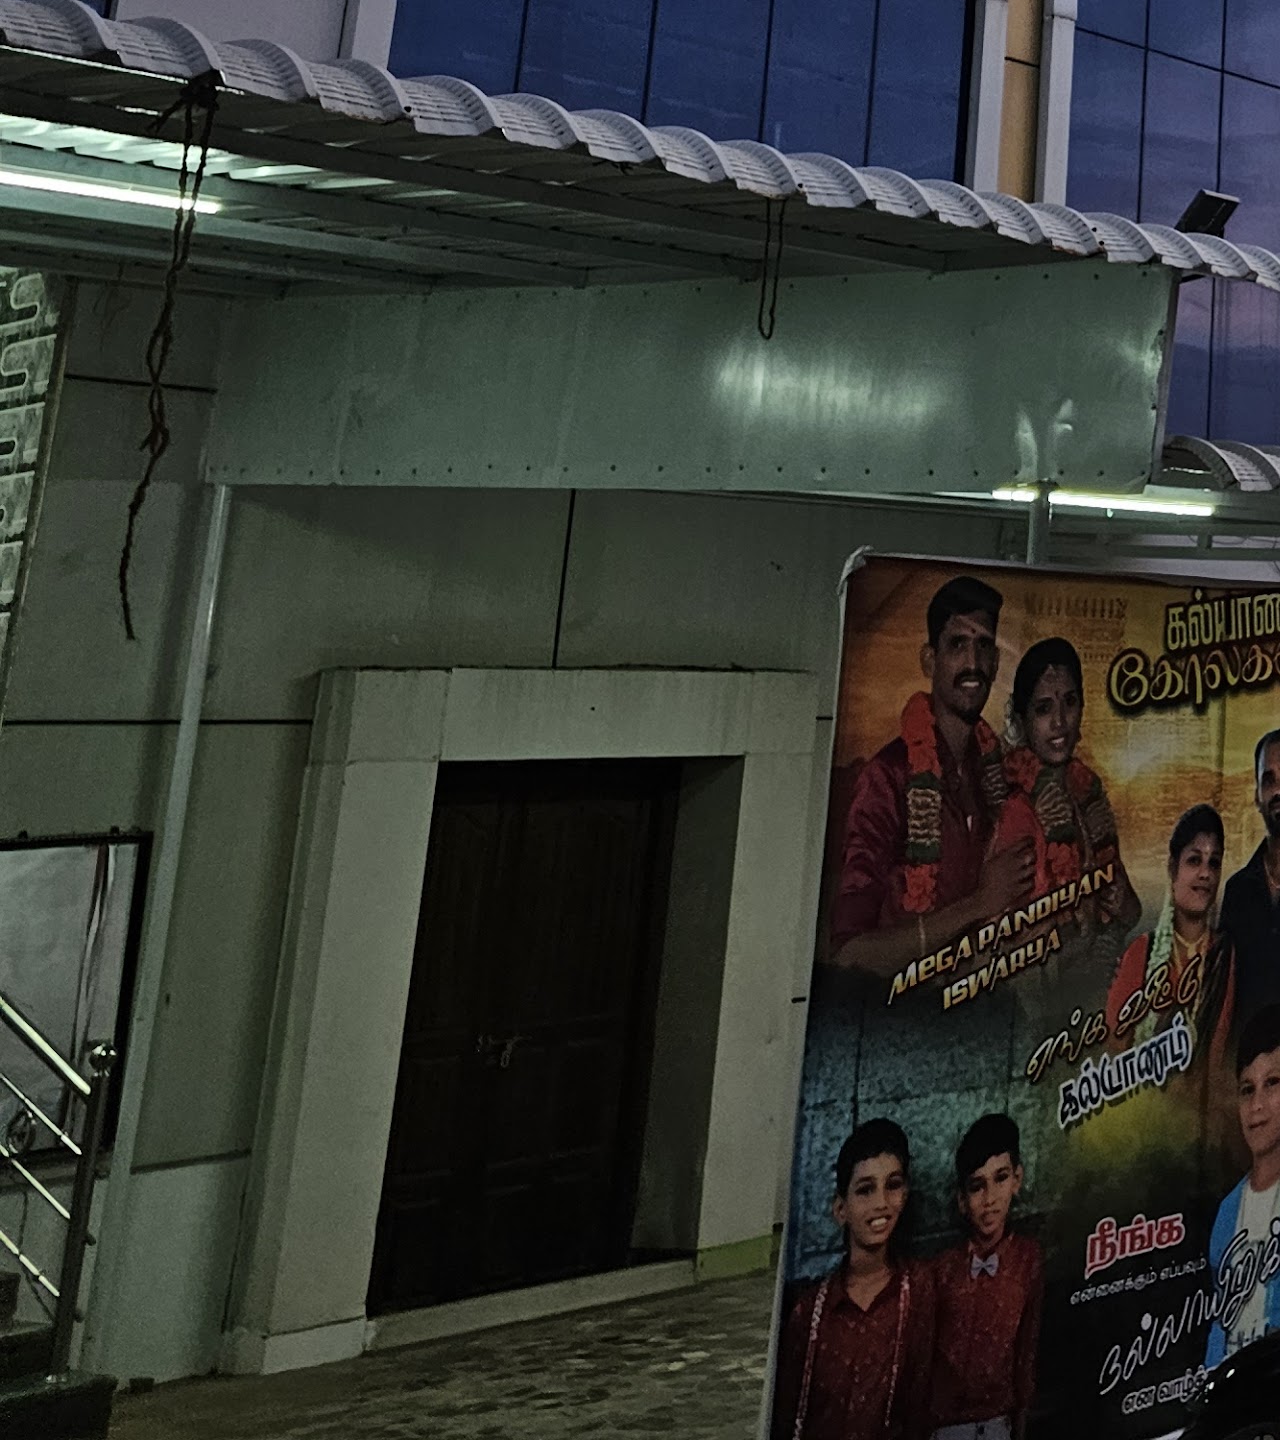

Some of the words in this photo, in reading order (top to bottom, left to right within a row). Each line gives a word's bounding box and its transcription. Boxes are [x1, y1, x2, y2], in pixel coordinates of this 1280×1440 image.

[942, 928, 1062, 1010] ISWARYA
[1059, 1012, 1192, 1128] கல்யாணம்
[1084, 1212, 1186, 1280] நீங்க
